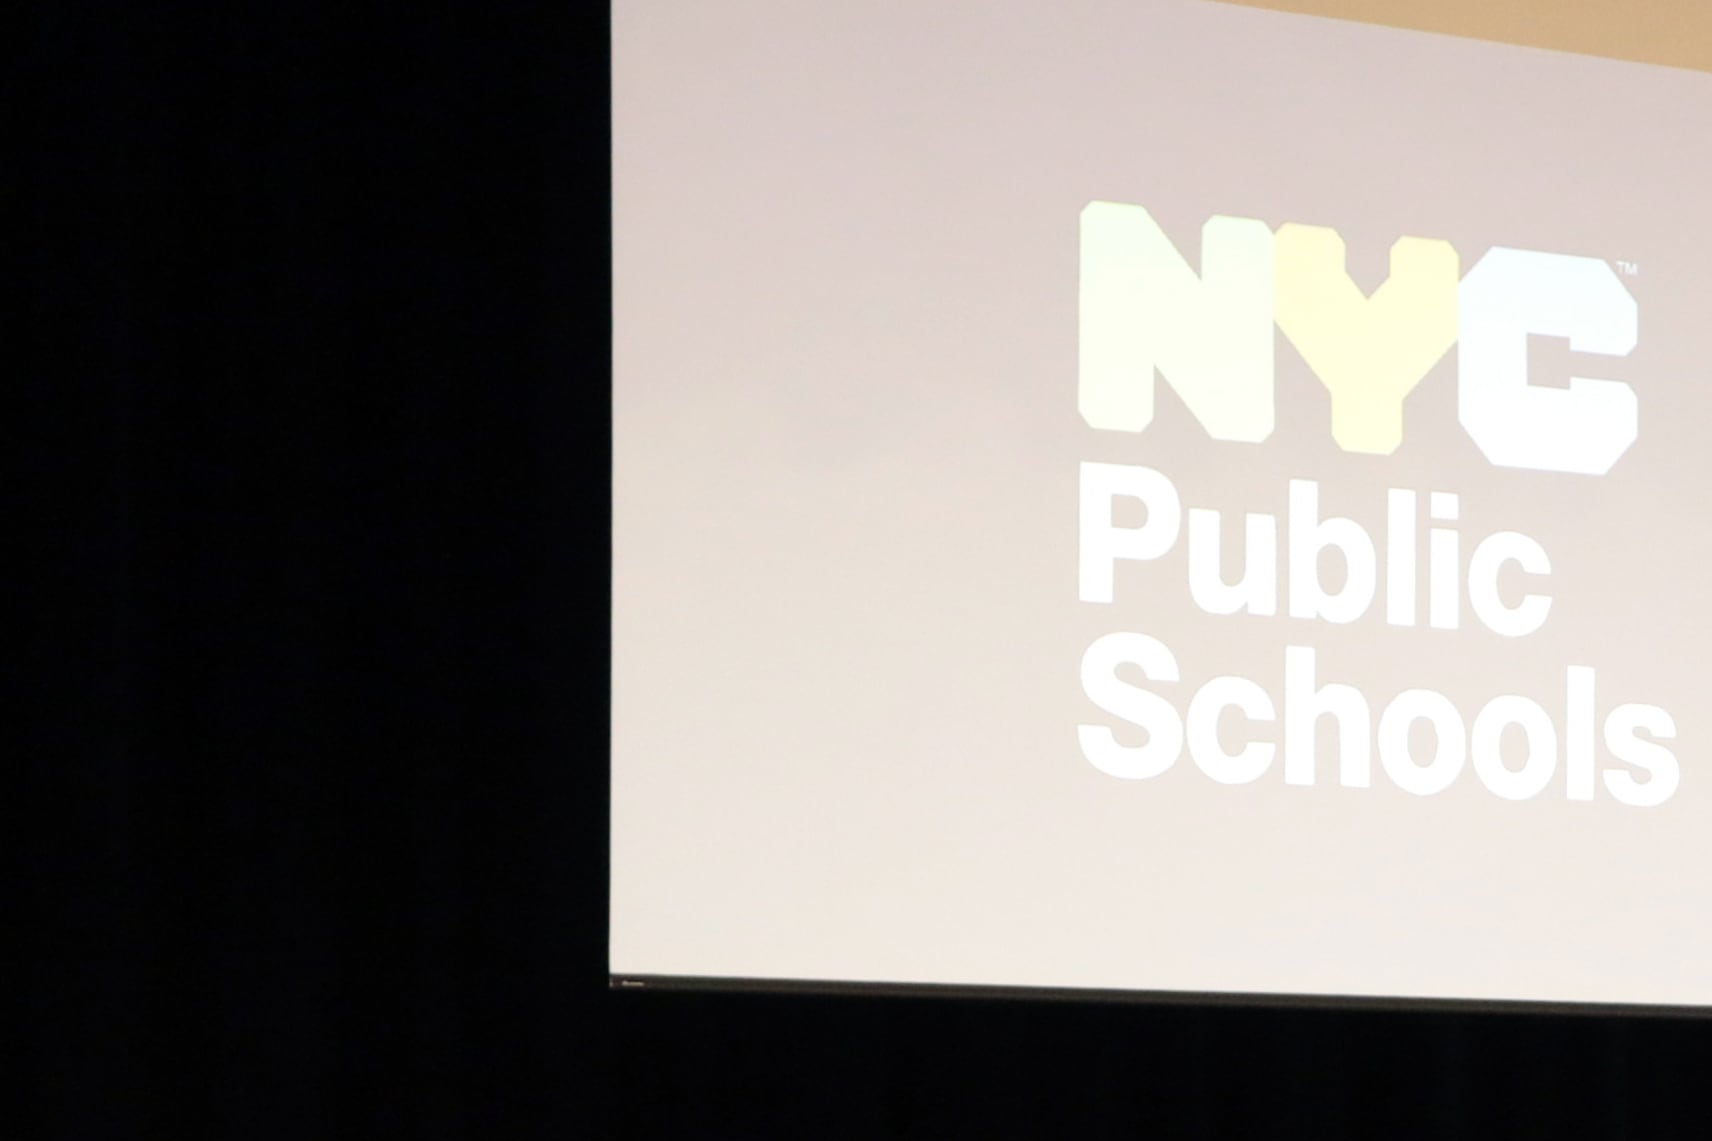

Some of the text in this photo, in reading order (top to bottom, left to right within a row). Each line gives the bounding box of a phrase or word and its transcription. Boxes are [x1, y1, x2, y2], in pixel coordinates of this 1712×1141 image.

[1078, 200, 1638, 475] NYC
[1078, 461, 1553, 637] Public
[1077, 631, 1680, 807] Schools
